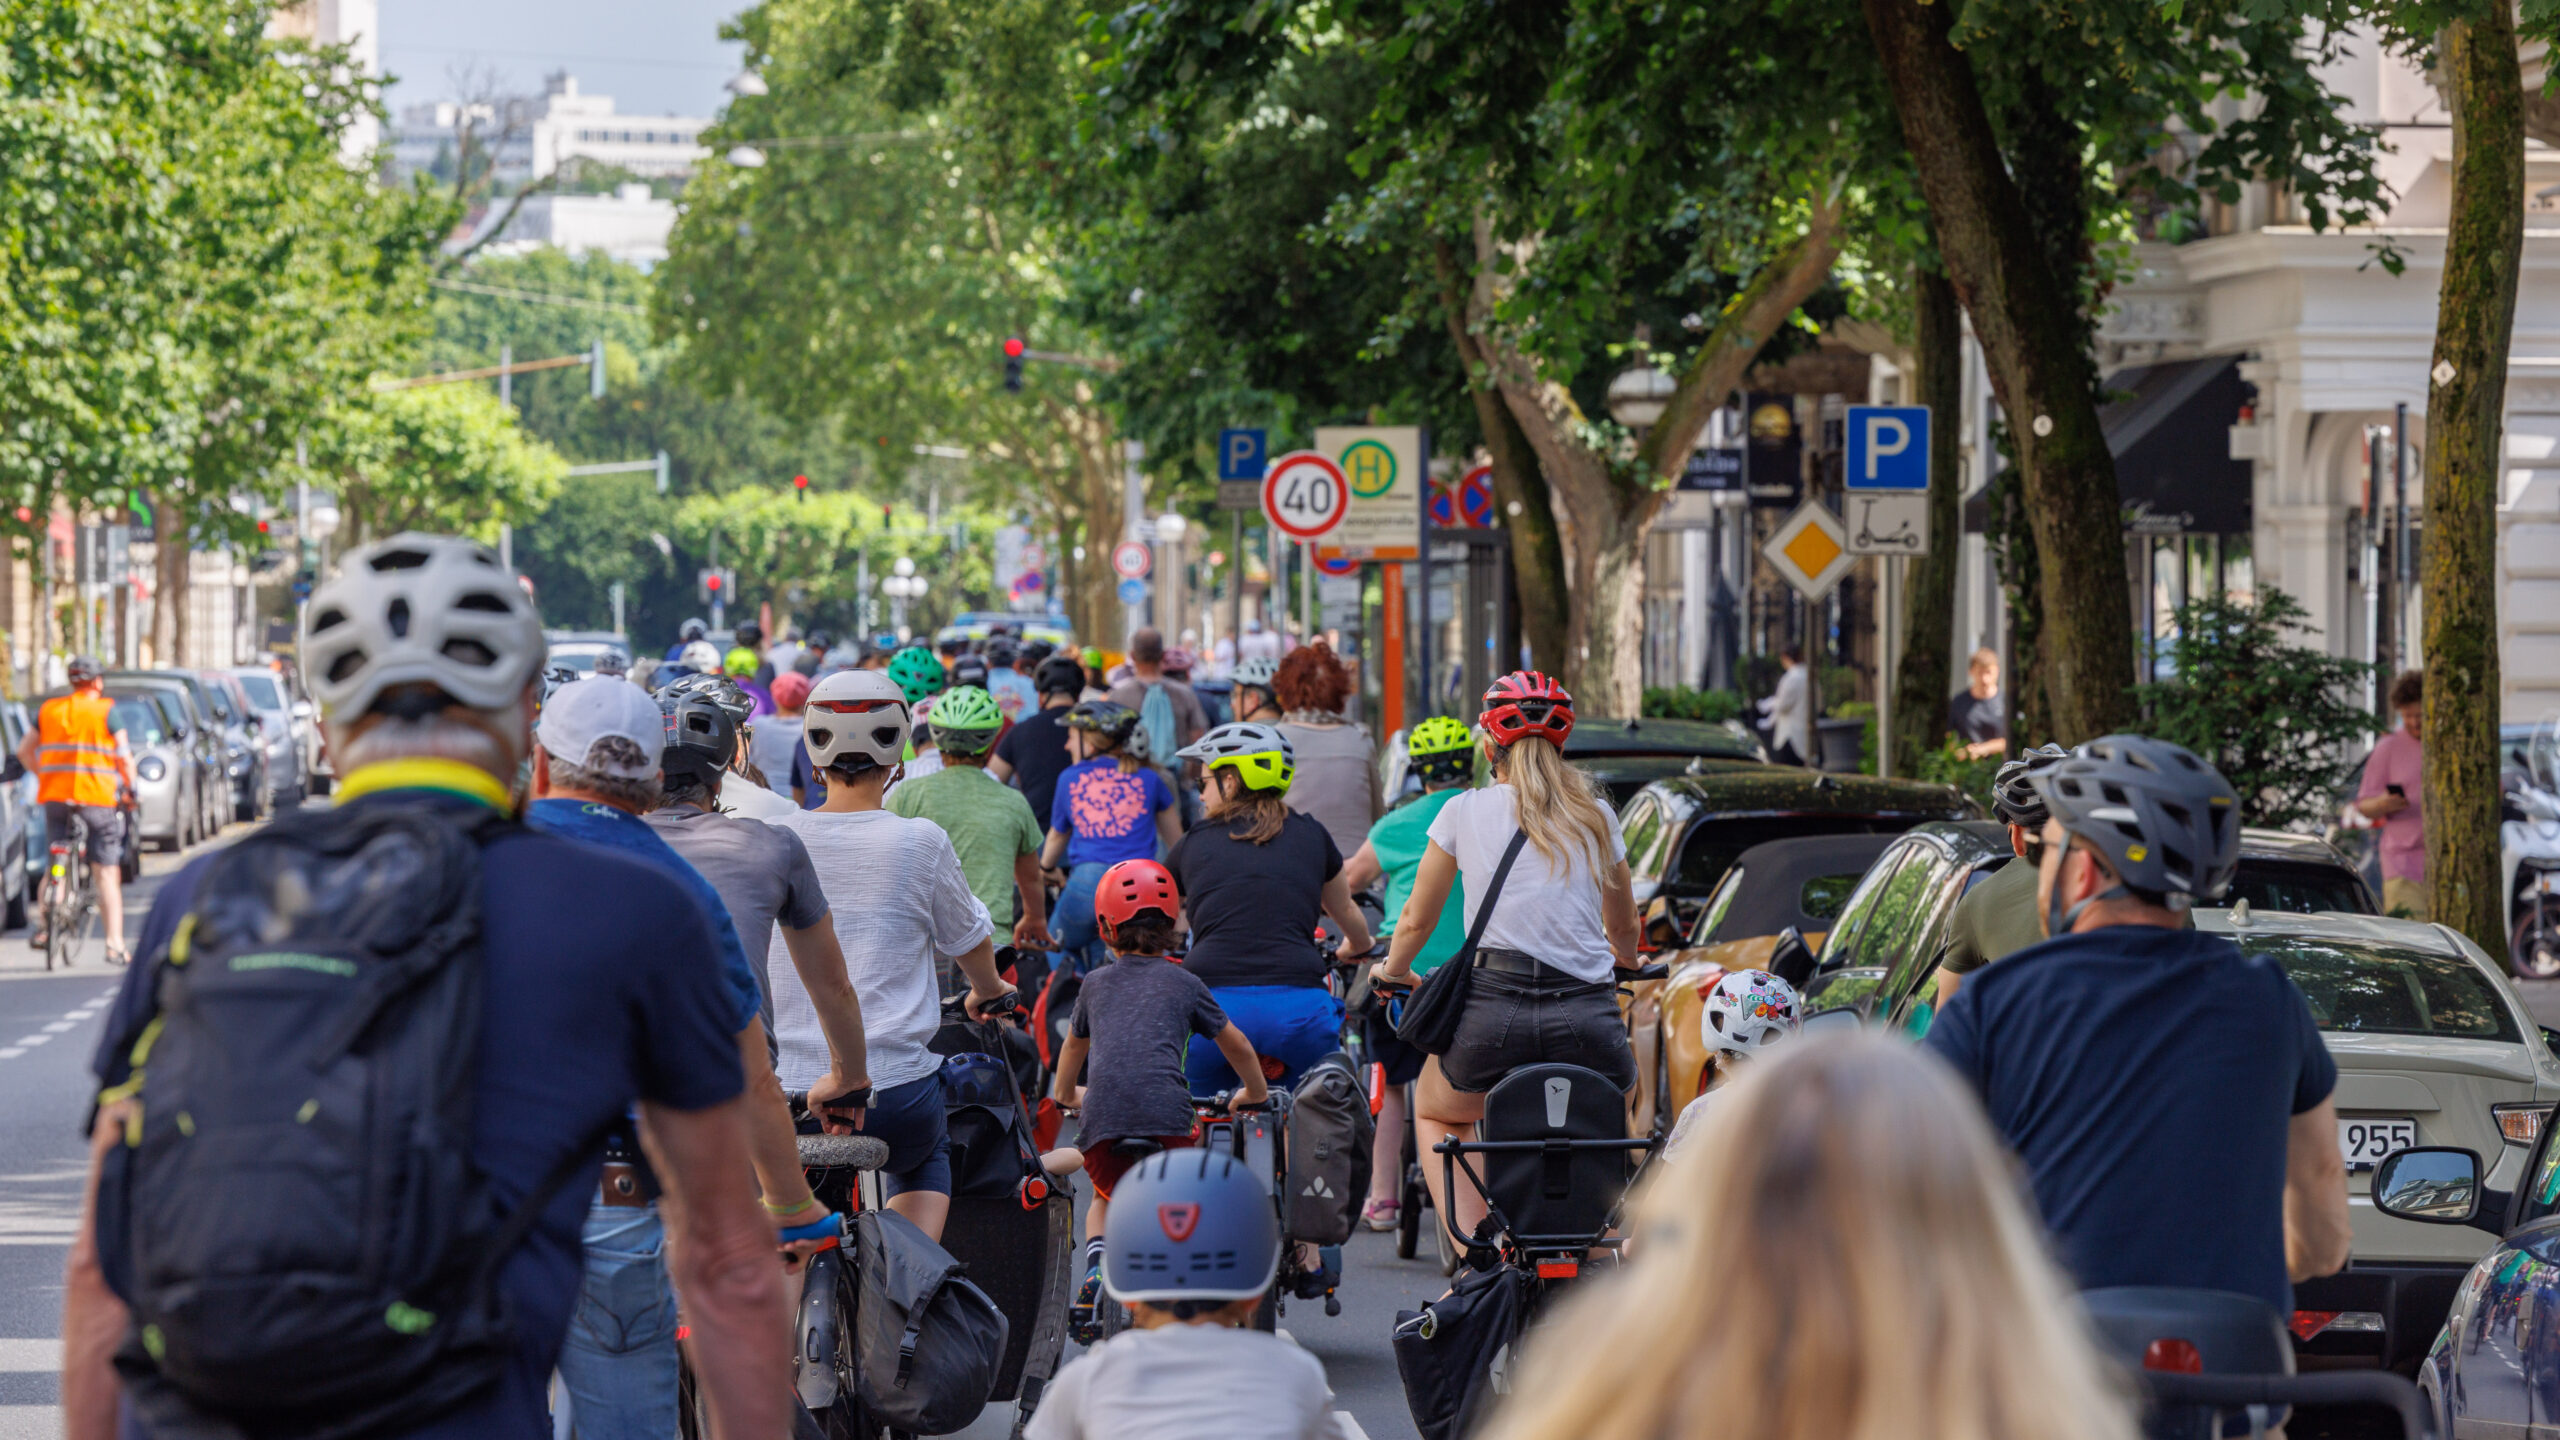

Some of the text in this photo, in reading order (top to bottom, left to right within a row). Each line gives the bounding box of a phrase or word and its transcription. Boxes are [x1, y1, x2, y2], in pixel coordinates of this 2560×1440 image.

[1229, 434, 1256, 474] P
[1866, 416, 1910, 479] P
[1356, 452, 1380, 485] H
[1283, 476, 1331, 515] 40
[2347, 1124, 2411, 1157] 955
